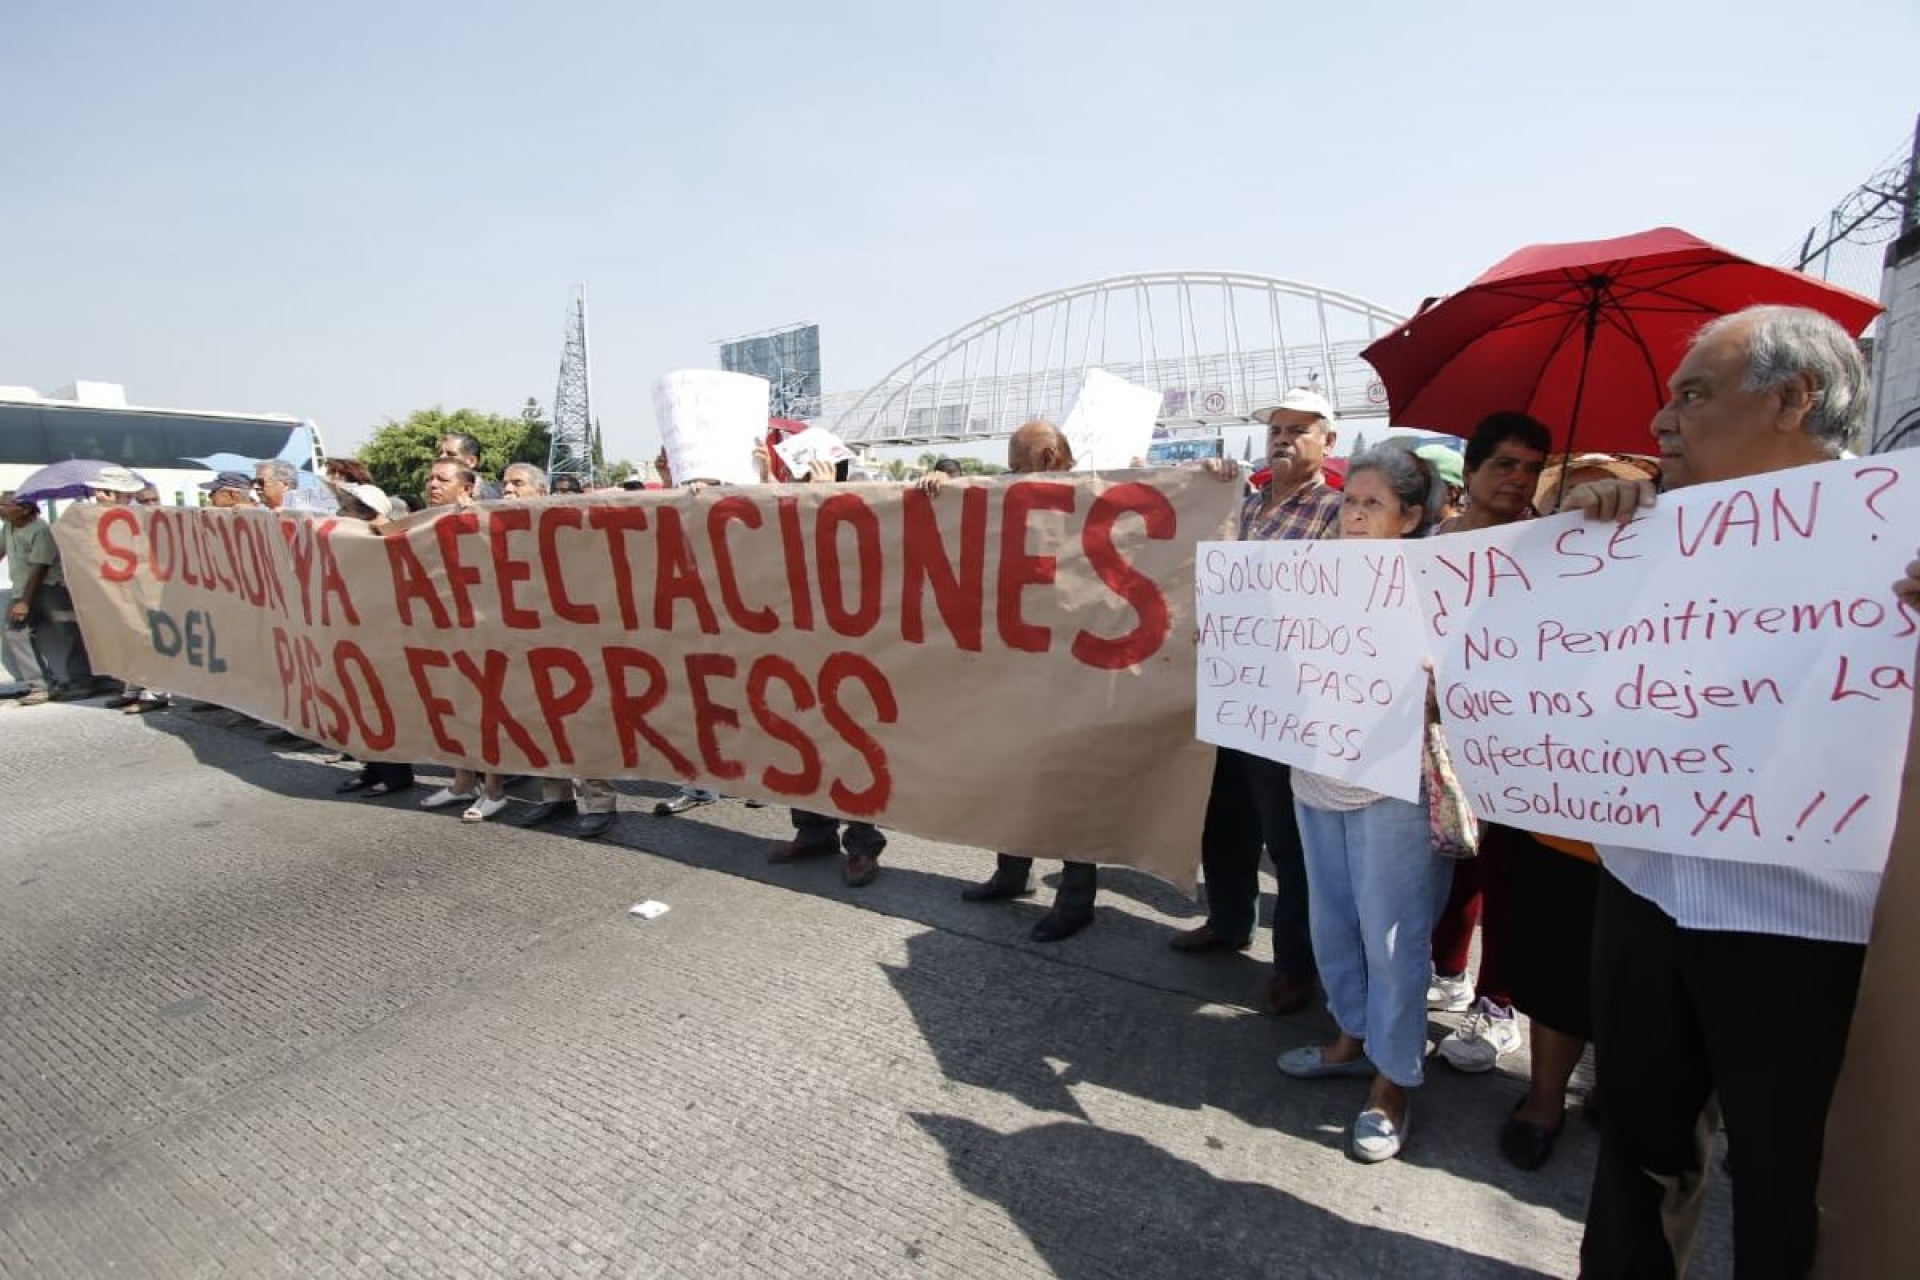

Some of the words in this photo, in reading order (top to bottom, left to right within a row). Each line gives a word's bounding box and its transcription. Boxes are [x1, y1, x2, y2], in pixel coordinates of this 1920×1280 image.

[96, 508, 289, 619] SOLUCION
[281, 518, 360, 626] YA
[384, 481, 1177, 671] AFECTACIONES
[1556, 516, 1649, 579] SE
[1364, 554, 1406, 613] YA
[1200, 612, 1377, 658] AFECTADOS
[1537, 596, 1917, 662] Permitiremos
[1205, 656, 1270, 689] DEL
[1297, 662, 1394, 706] PASO
[1445, 682, 1514, 722] Que
[1529, 690, 1594, 718] nos
[1614, 663, 1785, 719] dejen
[1830, 655, 1915, 702] La
[146, 609, 227, 674] DEL
[271, 626, 396, 751] PASO
[403, 646, 898, 817] EXPRESS
[1215, 700, 1364, 762] EXPRESS
